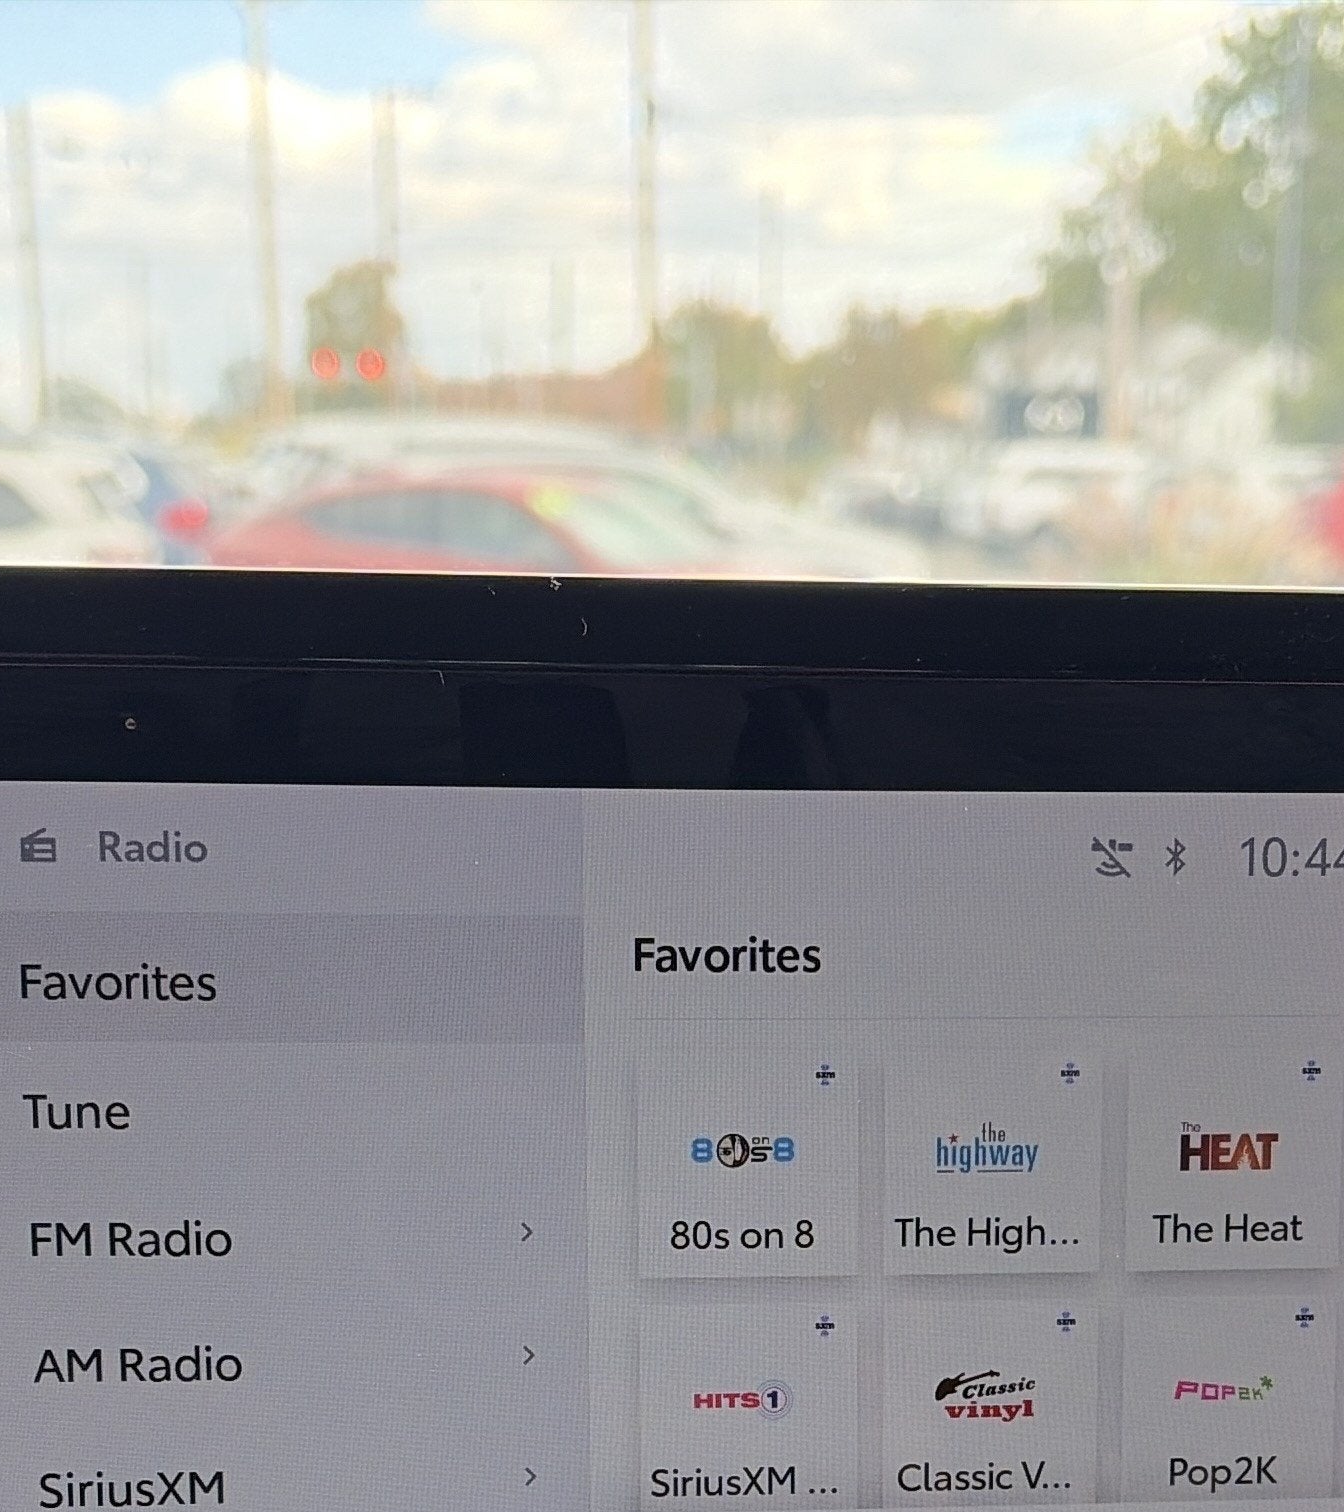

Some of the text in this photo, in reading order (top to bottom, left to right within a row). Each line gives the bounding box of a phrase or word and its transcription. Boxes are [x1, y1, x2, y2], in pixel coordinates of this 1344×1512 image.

[98, 829, 208, 864] Radio
[634, 935, 821, 974] Favorites
[20, 962, 217, 1002] Favorites
[22, 1094, 130, 1130] Tune
[1181, 1122, 1201, 1132] The
[981, 1122, 1006, 1142] the
[937, 1137, 1038, 1173] highway
[1180, 1133, 1279, 1171] HEAT
[30, 1219, 232, 1258] FM Radio
[670, 1219, 815, 1250] 80s on 8
[894, 1216, 956, 1248] The
[1152, 1213, 1304, 1244] The Heat
[33, 1344, 243, 1384] AM Radio
[962, 1377, 1035, 1399] Classic
[945, 1400, 1034, 1421] vinyl
[39, 1470, 224, 1509] SiriusXM
[651, 1465, 796, 1498] SiriusXM
[897, 1461, 1013, 1492] Classic
[1169, 1455, 1278, 1494] Pop2K
